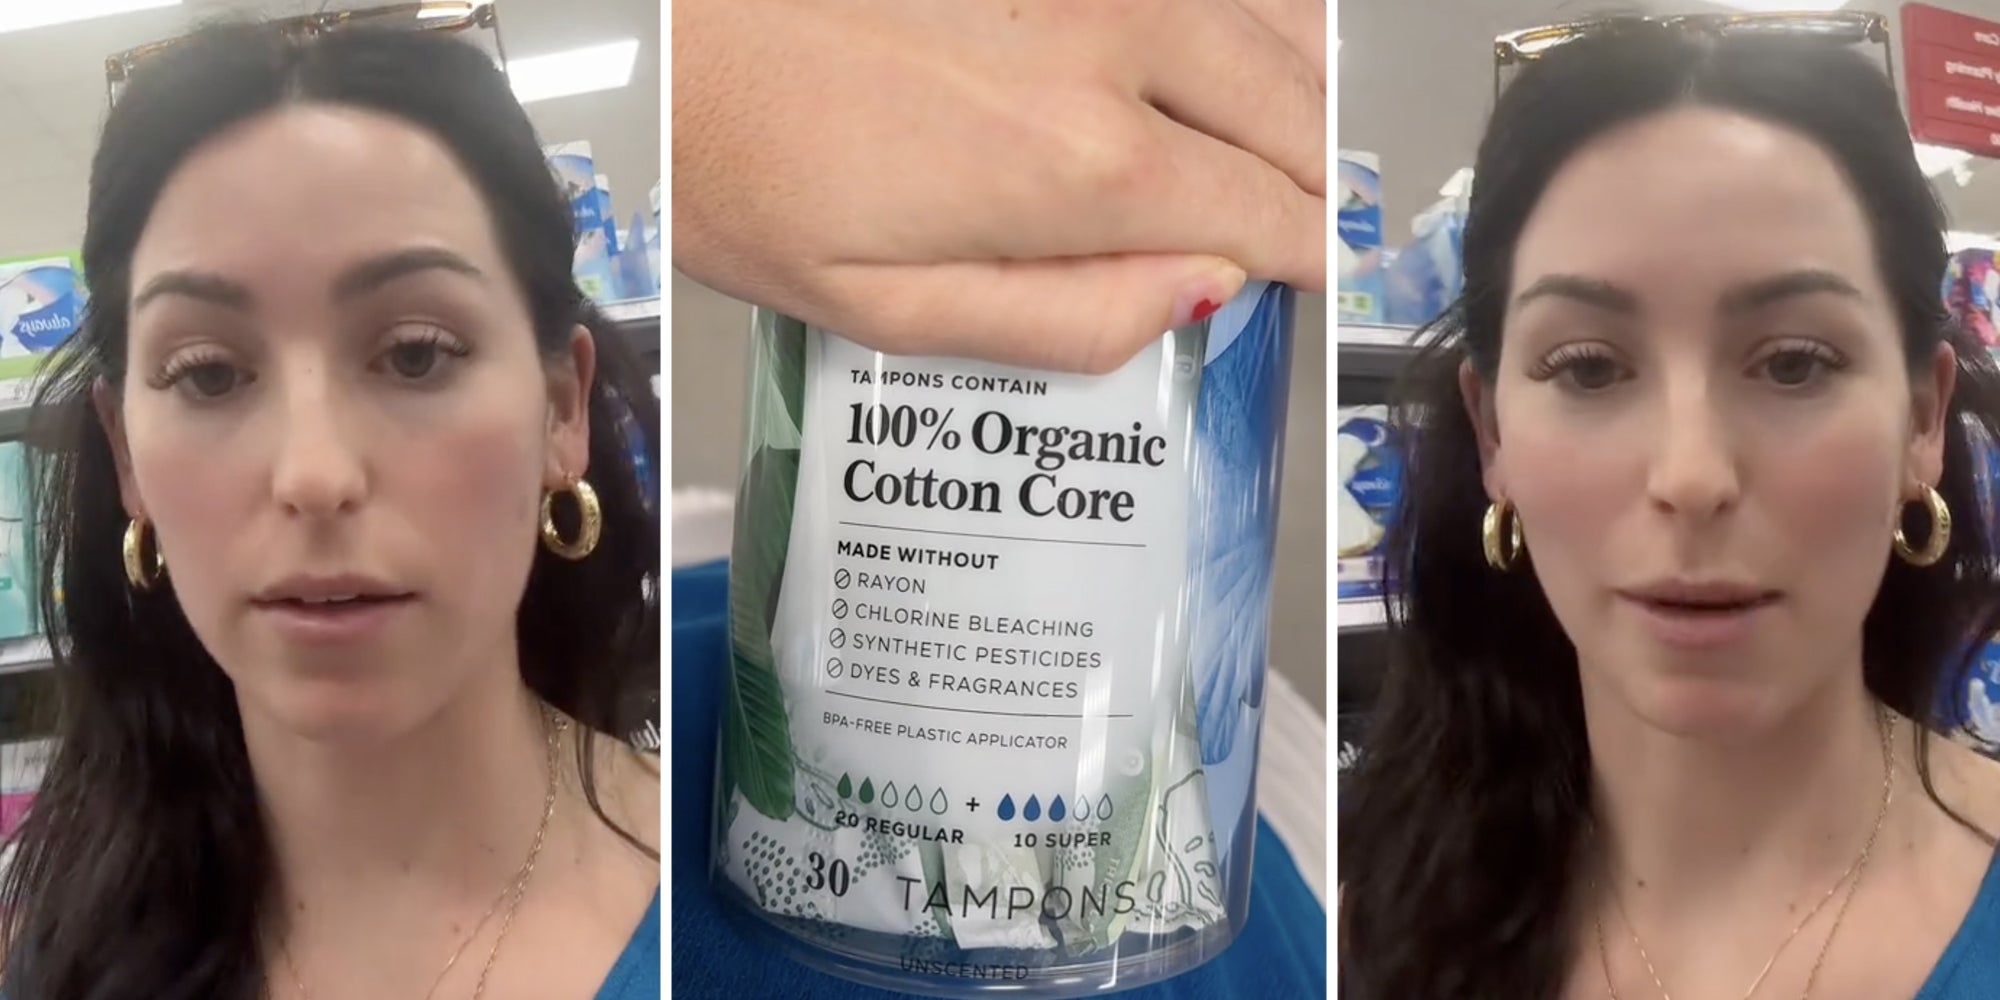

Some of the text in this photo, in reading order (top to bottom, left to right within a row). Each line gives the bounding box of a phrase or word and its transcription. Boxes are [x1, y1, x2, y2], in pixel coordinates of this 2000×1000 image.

[951, 375, 1047, 396] CONTAIN
[846, 402, 1166, 471] 100% Organic
[844, 459, 1135, 523] Cotton Core
[837, 540, 999, 570] MADE WITHOUT
[857, 572, 926, 594] RAYON
[855, 603, 1094, 638] CHLORINE BLEACHING
[852, 633, 1102, 669] SYNTHETIC PESTICIDES
[850, 662, 1079, 699] DYES & FRAGRANCES
[823, 712, 1068, 749] BPA-FREE PLASTIC APPLICATOR
[835, 810, 965, 844] 20 REGULAR
[1014, 832, 1112, 848] 10 SUPER
[806, 852, 849, 897] 30
[896, 876, 1136, 920] TAMPONS
[900, 956, 1029, 980] UNSCENTED
